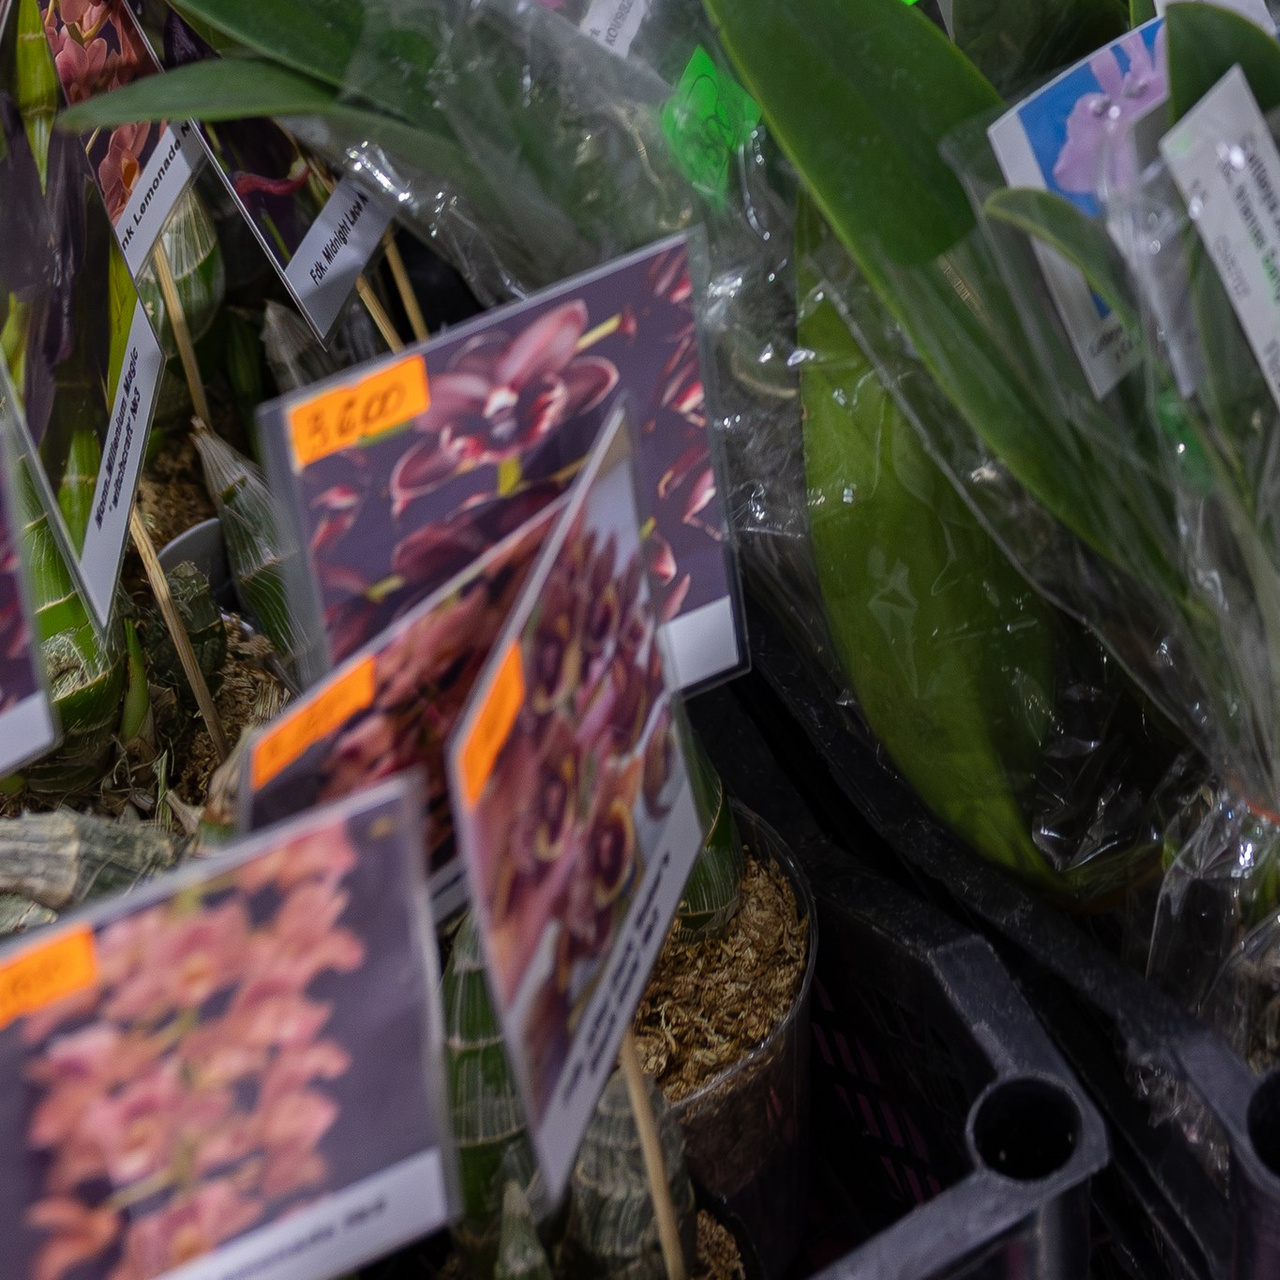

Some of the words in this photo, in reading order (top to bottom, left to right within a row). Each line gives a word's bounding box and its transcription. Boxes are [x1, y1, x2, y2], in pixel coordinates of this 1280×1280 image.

[309, 257, 331, 287] Fdk.
[323, 215, 351, 266] Midnight
[122, 345, 140, 397] Magic
